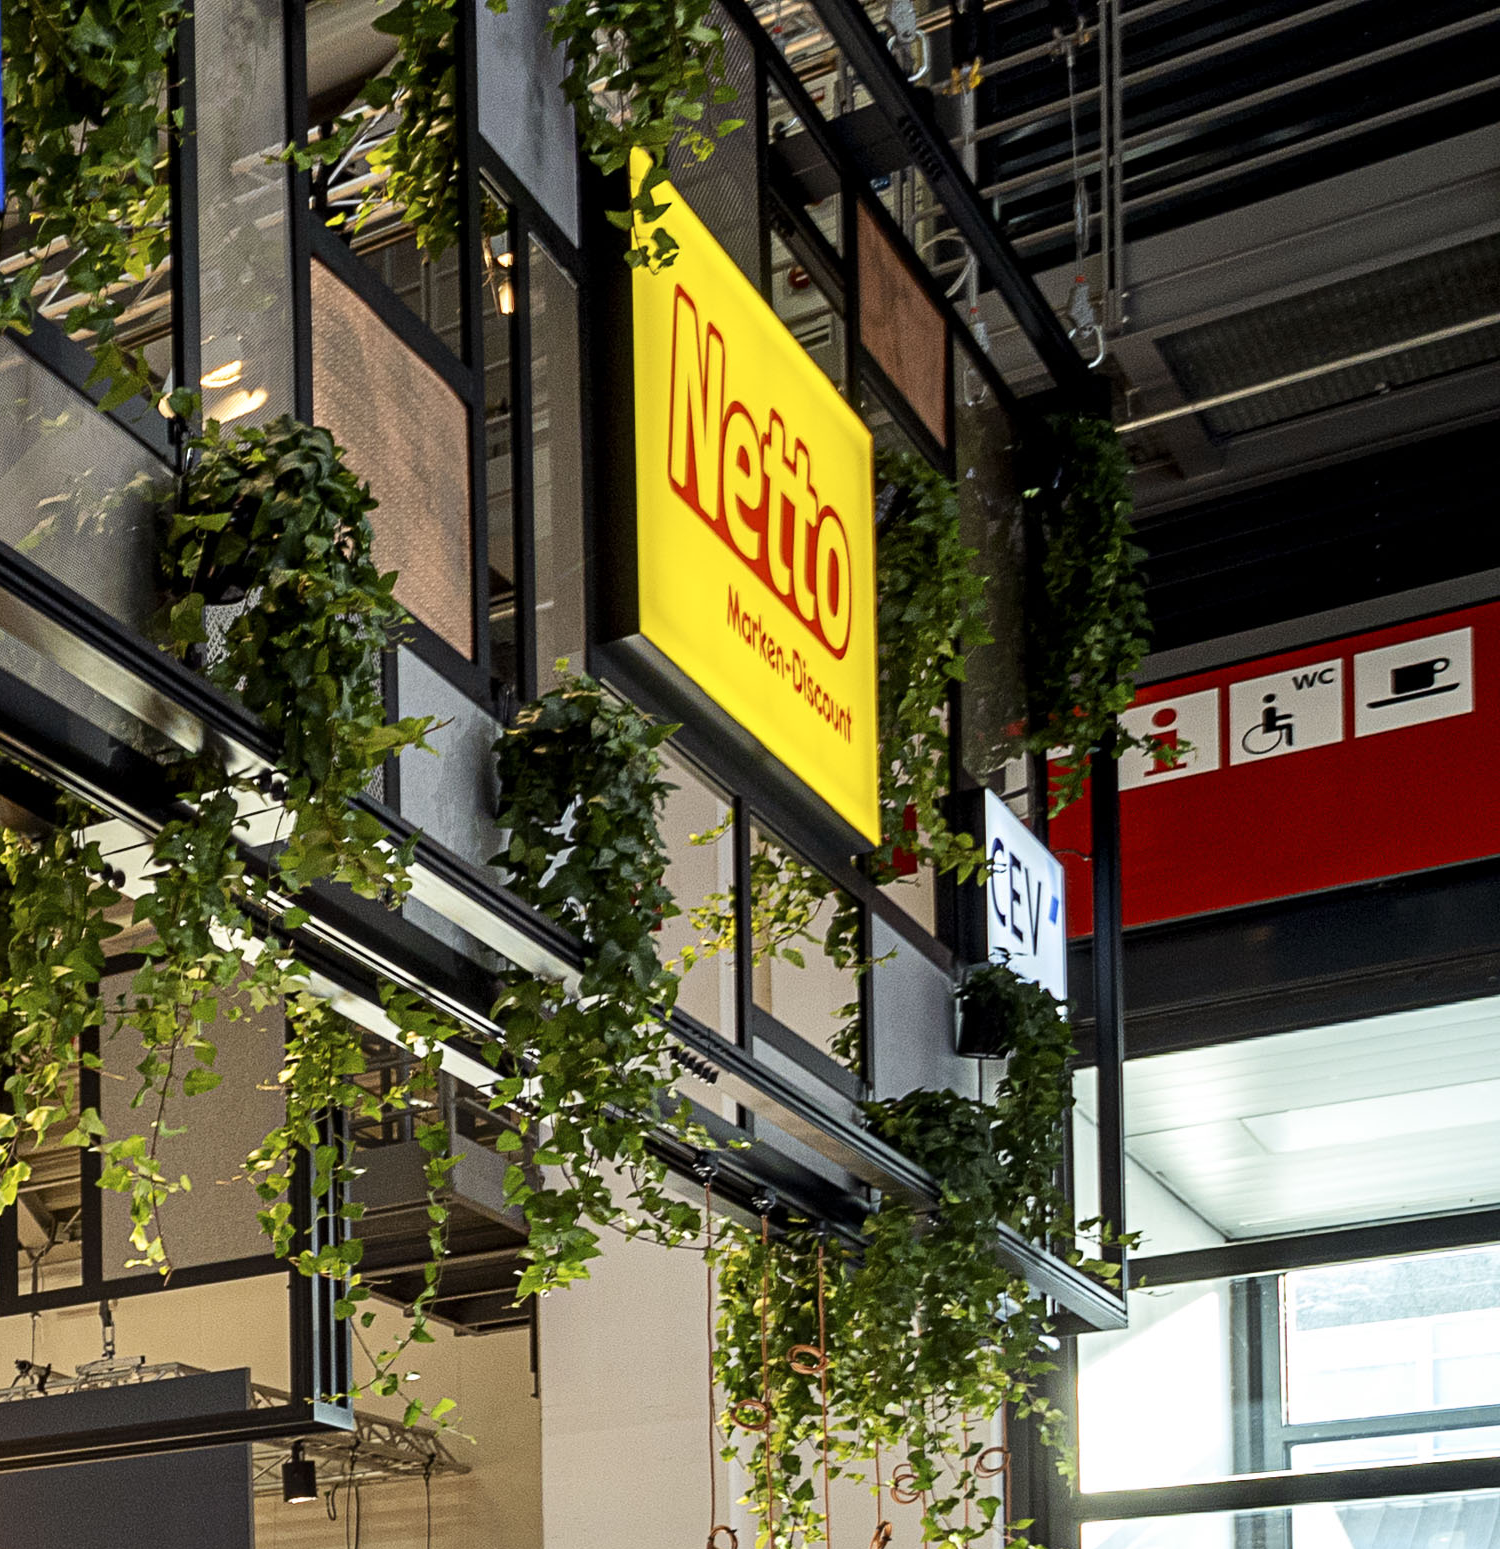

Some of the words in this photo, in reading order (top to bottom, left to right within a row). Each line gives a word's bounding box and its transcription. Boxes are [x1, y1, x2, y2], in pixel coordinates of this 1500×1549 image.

[668, 283, 852, 660] Netto
[727, 584, 852, 744] Marken-Discount
[1292, 668, 1336, 691] WC
